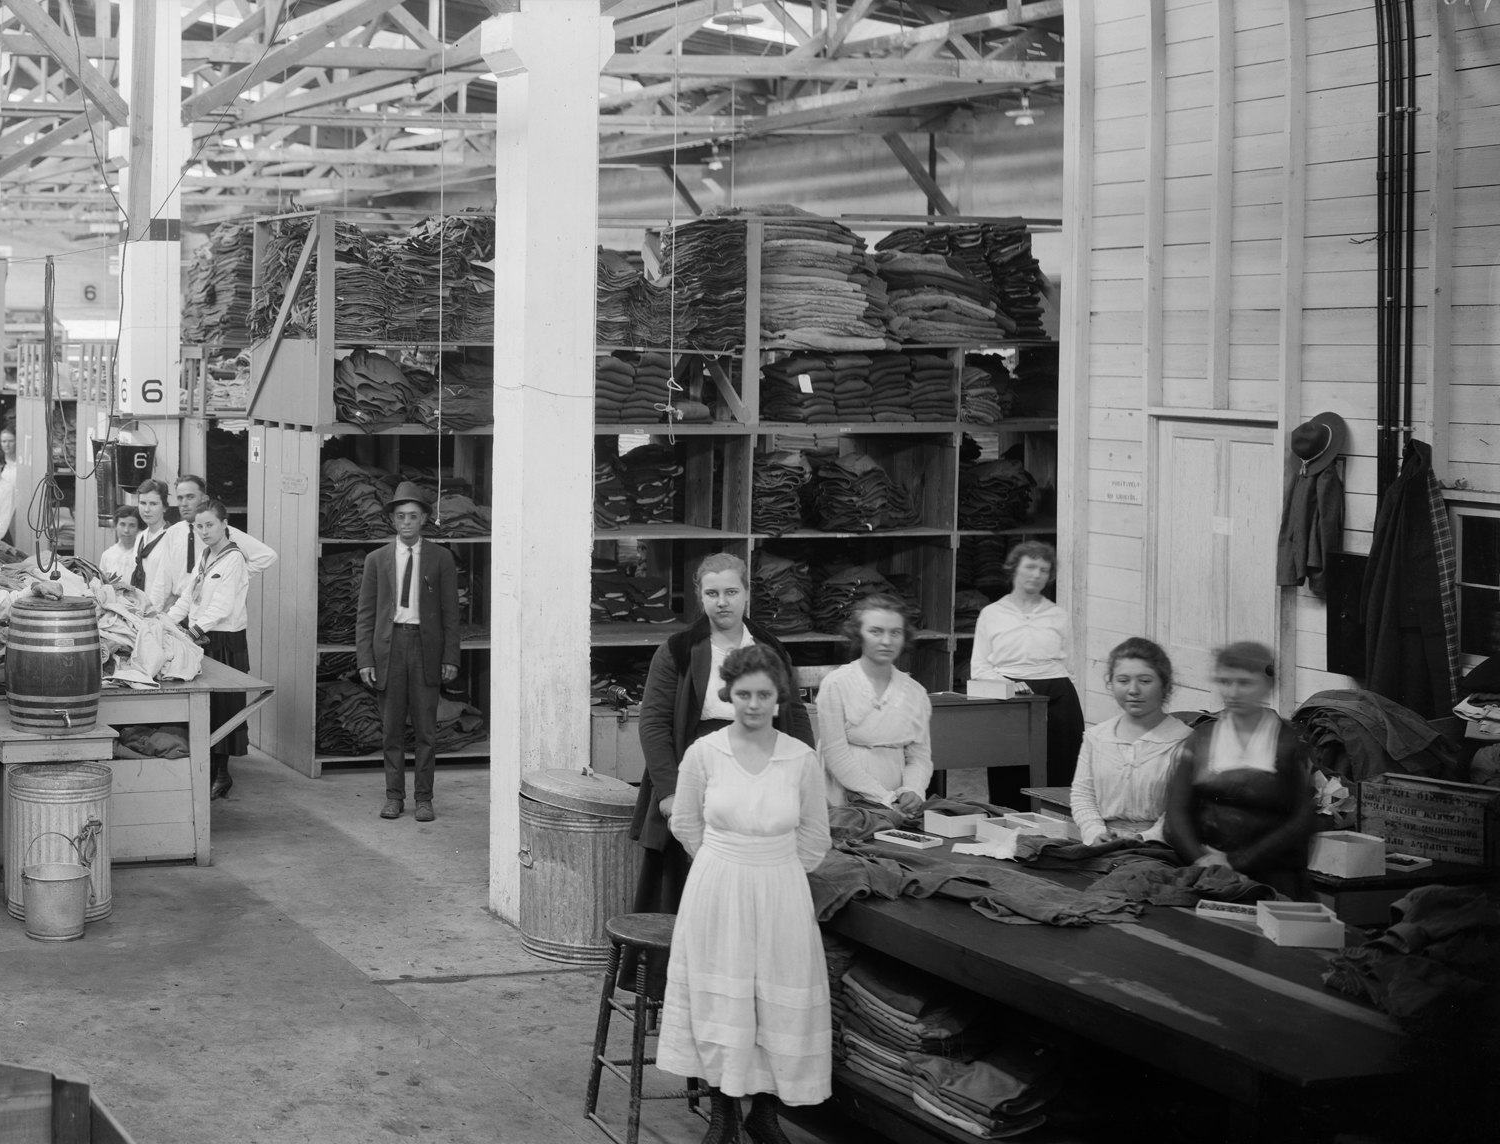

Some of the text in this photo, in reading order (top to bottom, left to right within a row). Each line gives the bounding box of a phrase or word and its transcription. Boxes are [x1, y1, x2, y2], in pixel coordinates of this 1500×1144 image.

[83, 284, 97, 301] 6
[121, 378, 127, 403] 6
[141, 379, 163, 403] 6
[134, 452, 148, 469] 6
[1380, 788, 1410, 798] TEXAS
[1421, 825, 1479, 839] WAREHOUSE
[1410, 841, 1448, 853] SUPPLY
